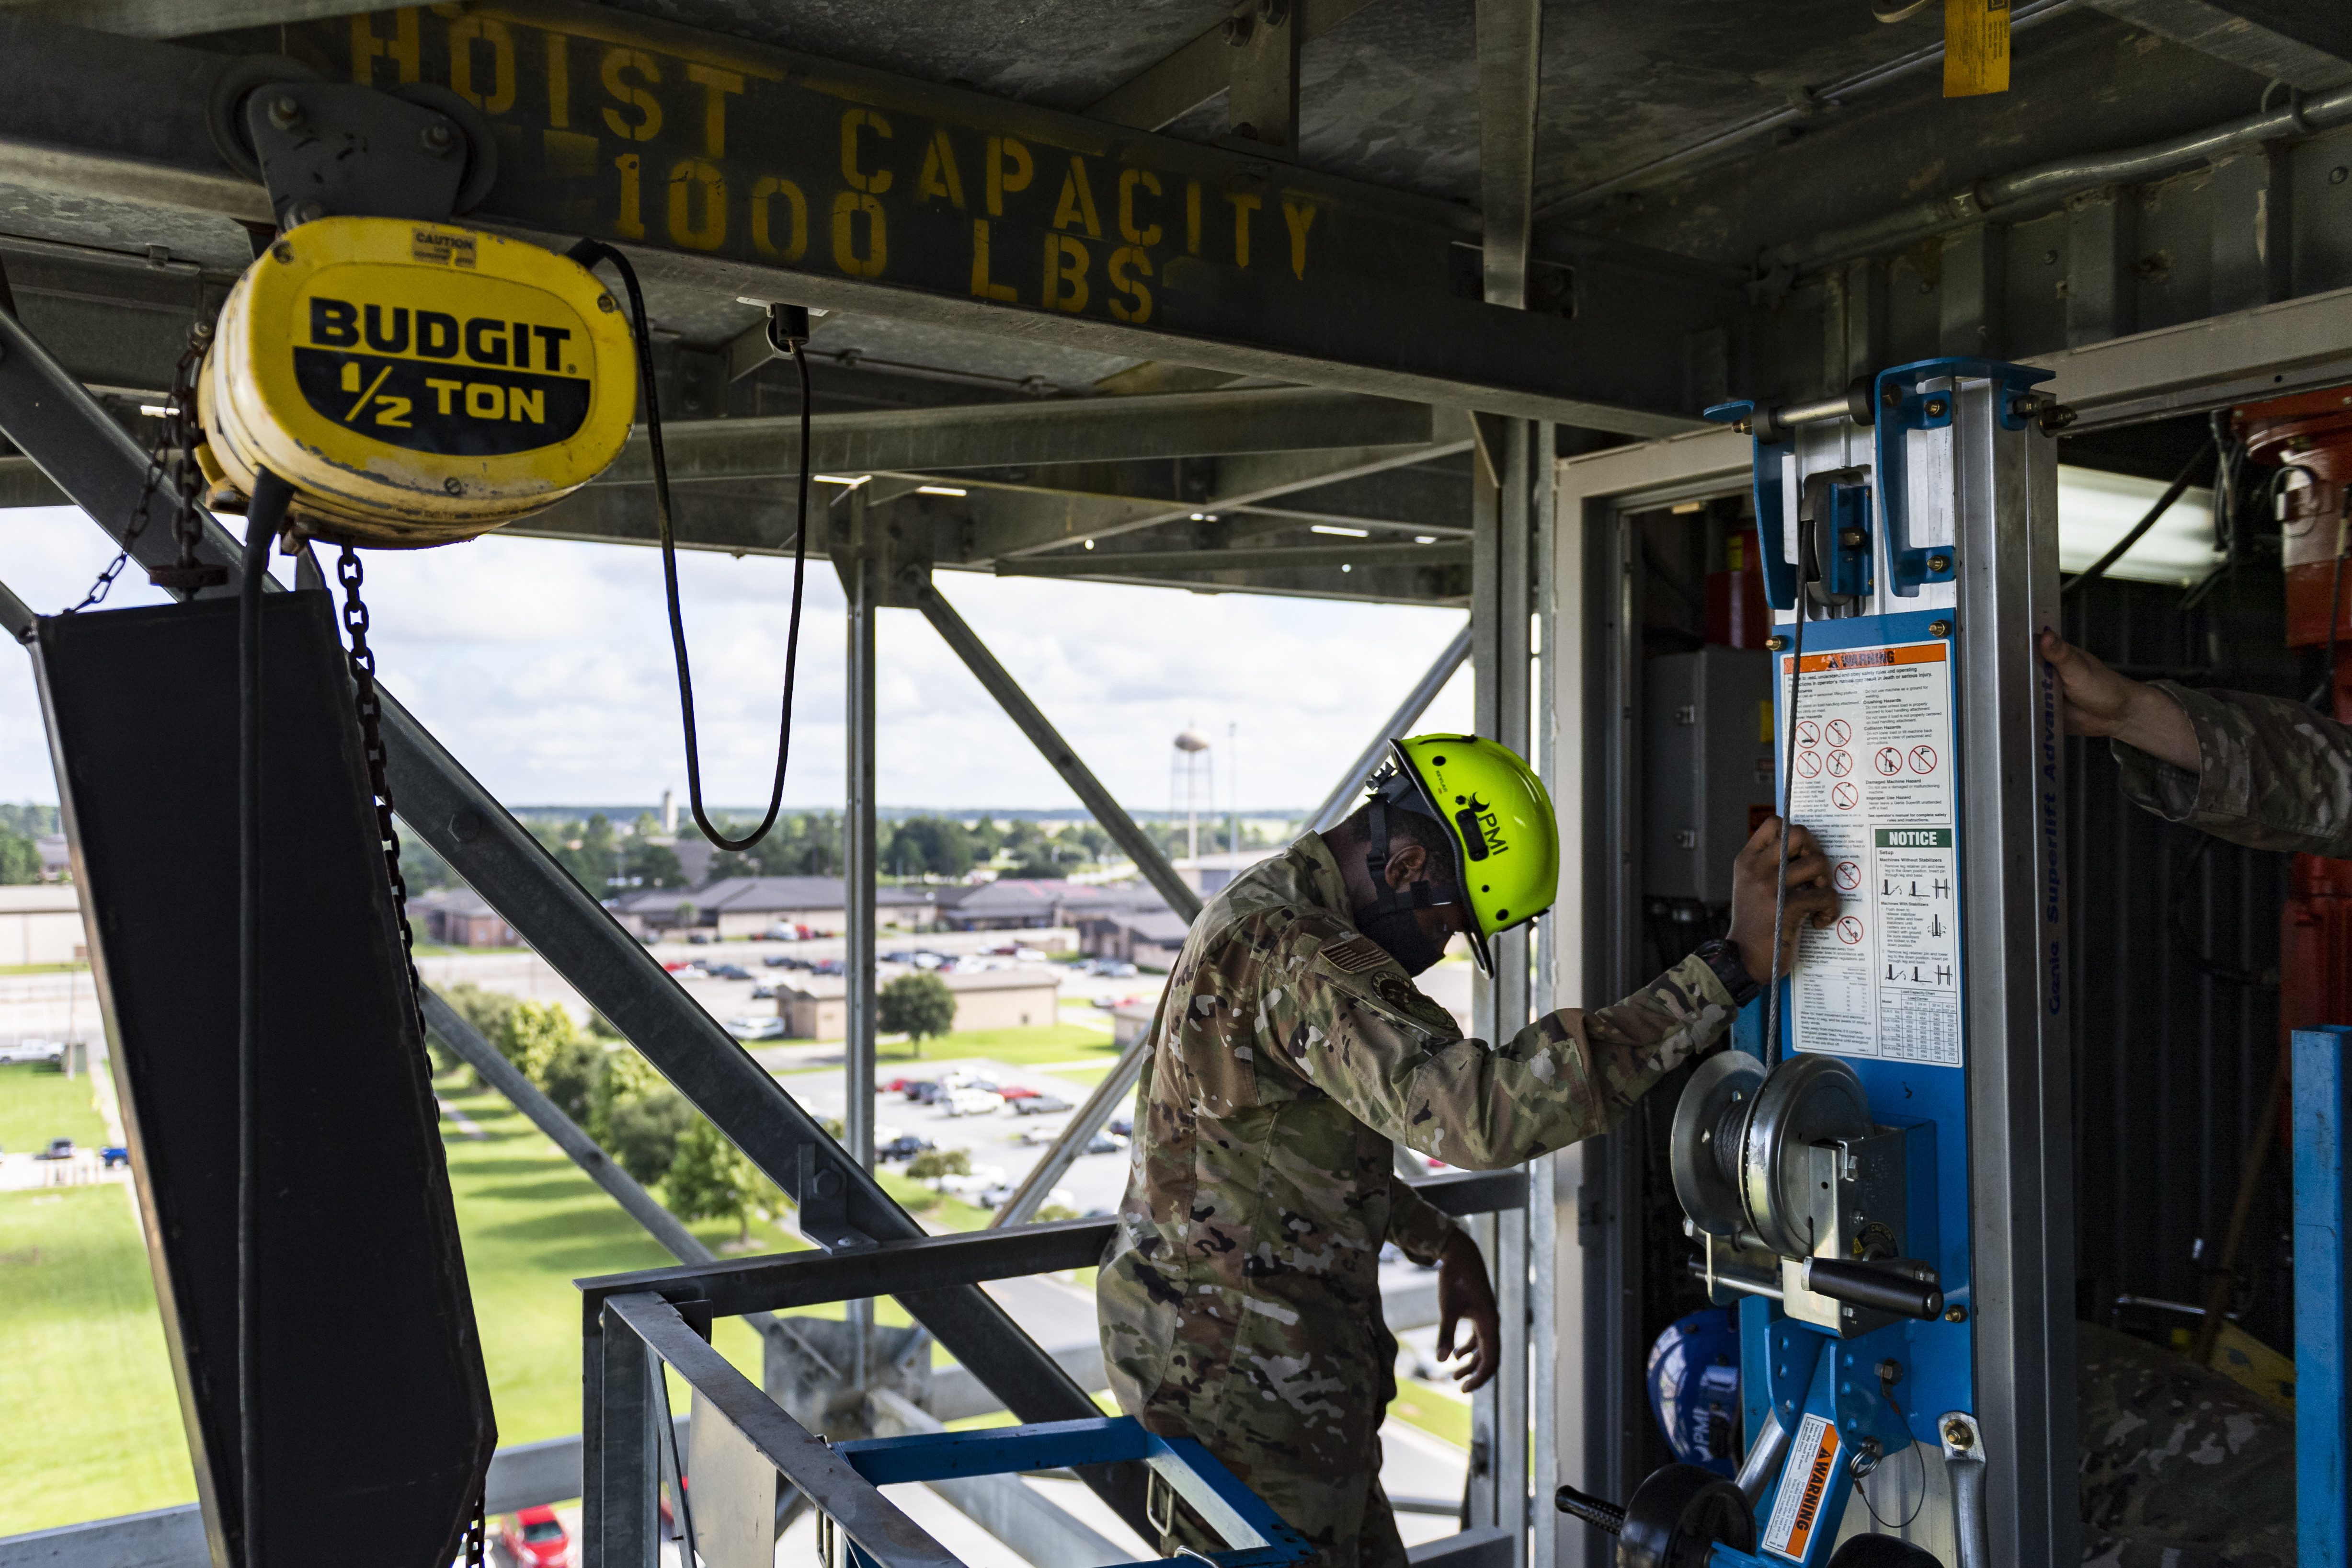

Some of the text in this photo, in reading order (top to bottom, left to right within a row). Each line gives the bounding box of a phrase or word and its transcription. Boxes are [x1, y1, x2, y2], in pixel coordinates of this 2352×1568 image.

[350, 7, 1318, 282] HOIST CAPACITY
[415, 232, 473, 250] CAUTION
[613, 152, 1153, 324] 1000 LBS
[309, 296, 571, 372] BUDGIT
[340, 362, 546, 428] 1/2 TON
[1841, 651, 1895, 667] WARNING
[1477, 813, 1509, 856] PMI
[1889, 831, 1937, 845] NOTICE
[2044, 792, 2060, 924] Superlift
[2049, 940, 2060, 1015] Genie
[1871, 1224, 1893, 1241] CAUTION
[1796, 1462, 1829, 1532] WARNING
